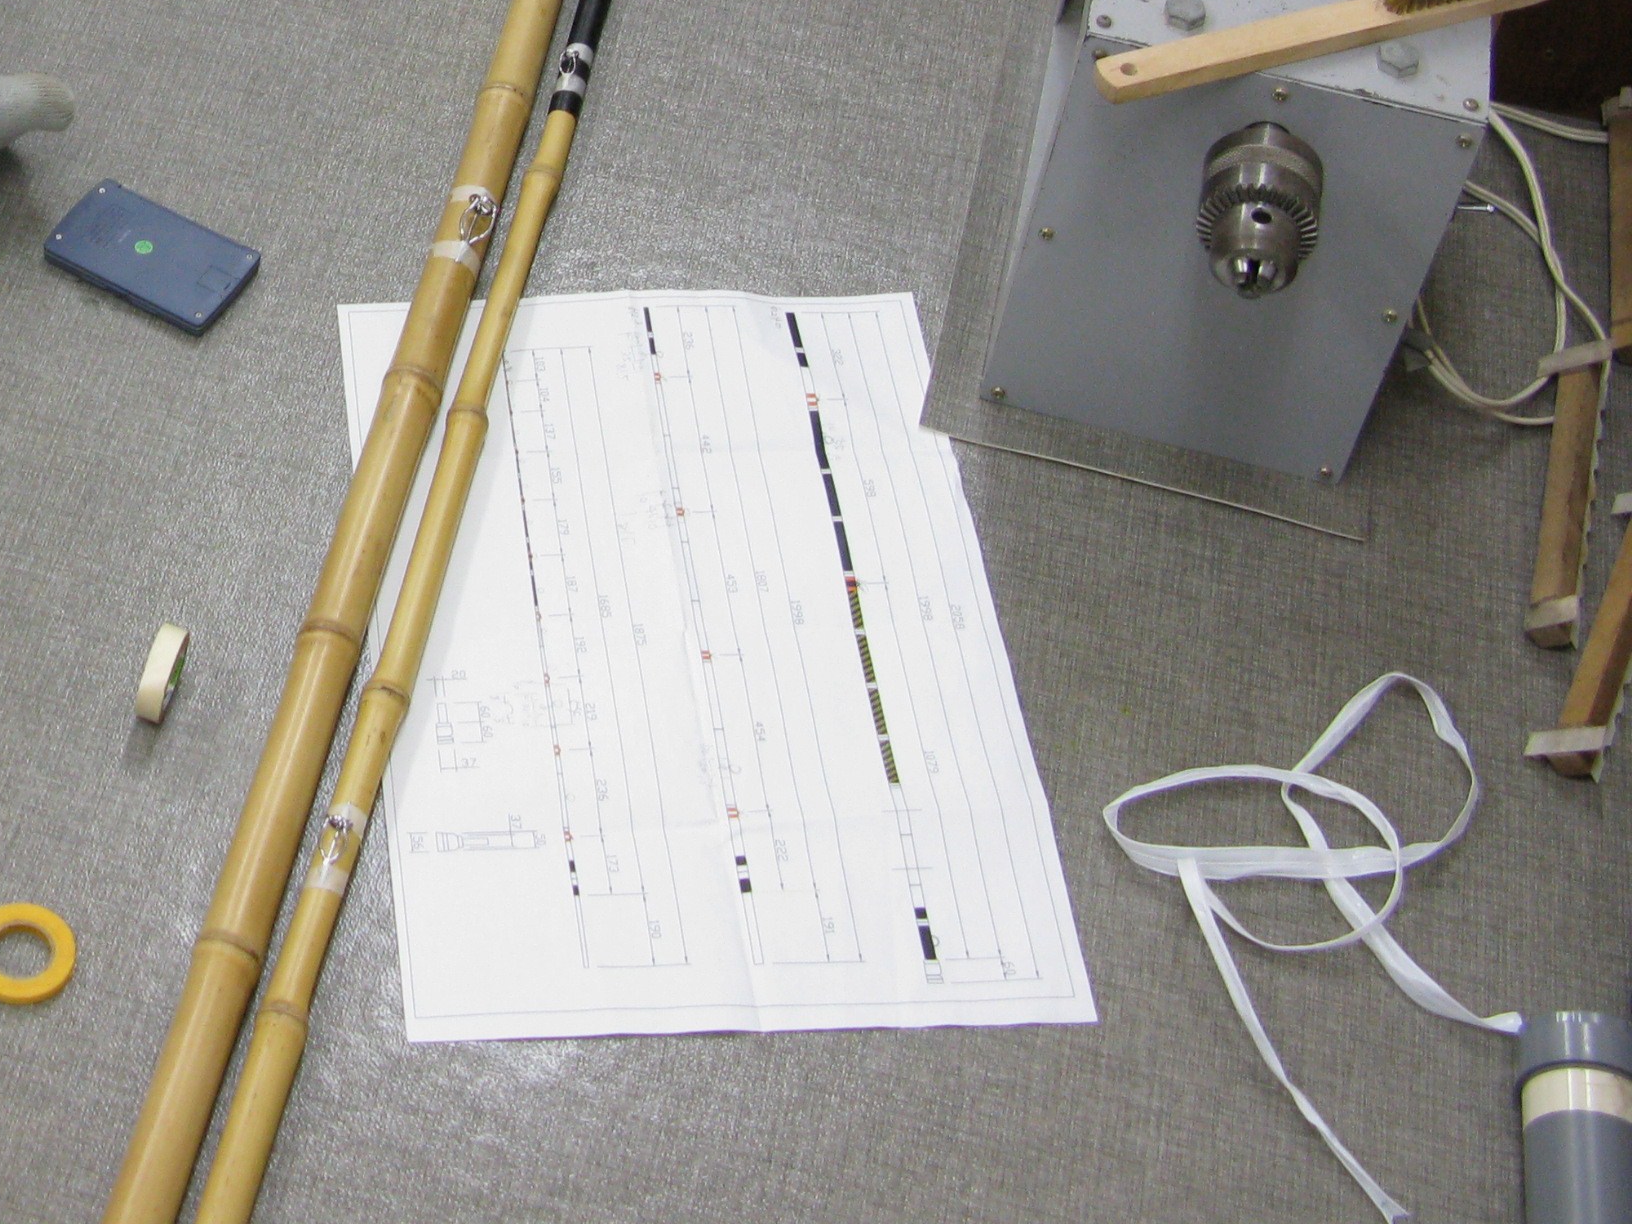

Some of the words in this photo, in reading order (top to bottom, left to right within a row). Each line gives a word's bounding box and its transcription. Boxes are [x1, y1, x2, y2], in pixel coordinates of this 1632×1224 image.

[544, 423, 555, 440] 137
[701, 435, 712, 454] 442
[550, 467, 562, 484] 155
[726, 574, 738, 593] 453
[755, 570, 768, 592] 1807
[598, 595, 611, 618] 1685
[790, 600, 804, 625] 1998
[918, 596, 933, 621] 1998
[950, 604, 965, 630] 2058
[633, 623, 647, 646] 1875
[574, 636, 587, 653] 192
[452, 670, 466, 680] 20
[479, 706, 489, 718] 60
[585, 703, 596, 721] 219
[482, 726, 493, 738] 60
[755, 721, 766, 741] 454
[462, 758, 476, 766] 37
[924, 750, 938, 774] 1079
[596, 779, 608, 801] 236
[510, 815, 521, 828] 37
[775, 840, 787, 862] 222
[607, 855, 619, 872] 173
[648, 920, 661, 939] 190
[822, 917, 835, 934] 191
[1004, 962, 1017, 975] 60
